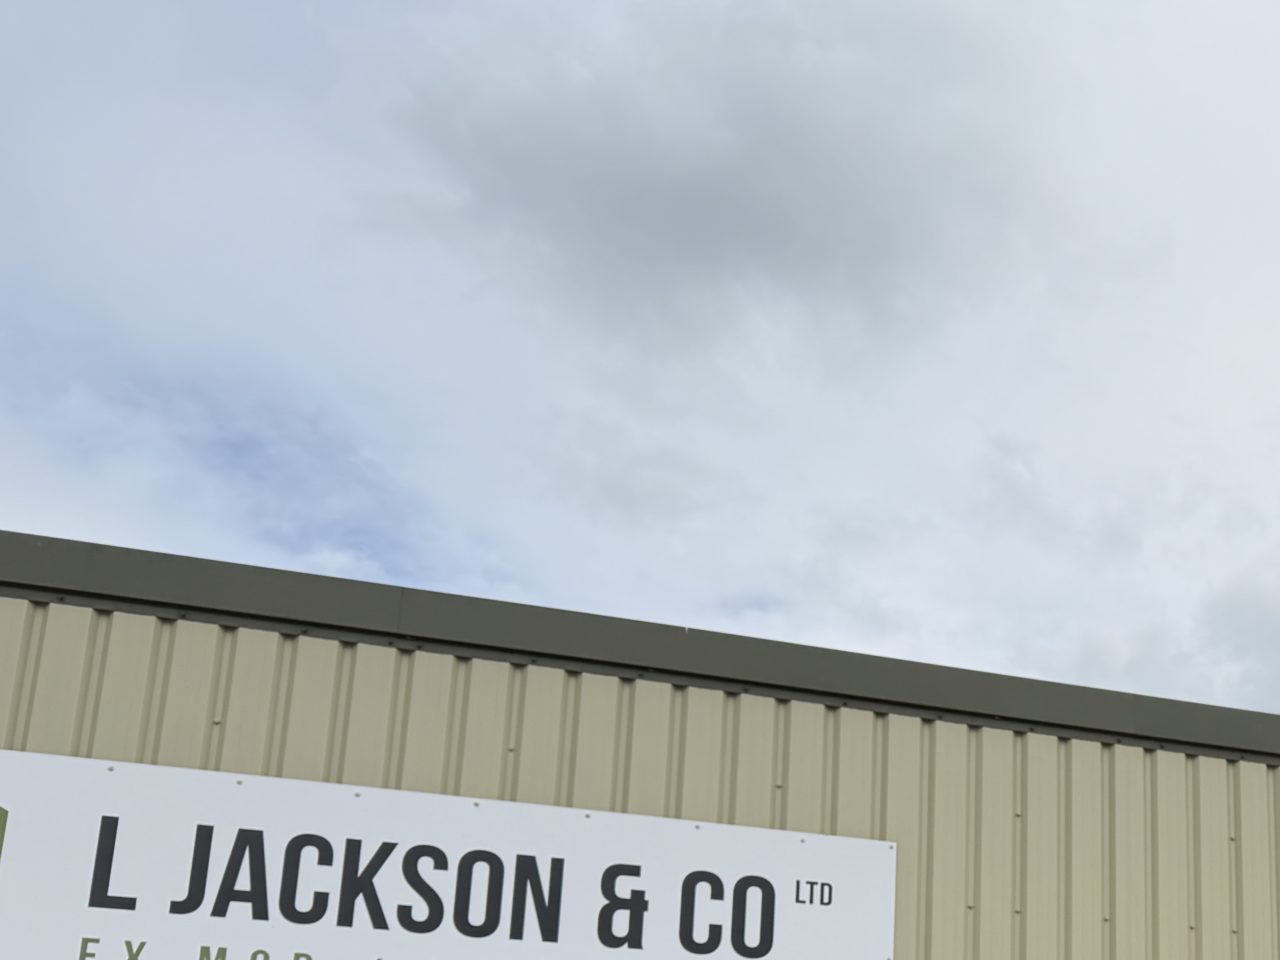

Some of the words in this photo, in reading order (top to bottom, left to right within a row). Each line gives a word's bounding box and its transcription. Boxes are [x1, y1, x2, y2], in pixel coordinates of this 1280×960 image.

[87, 814, 138, 912] L
[168, 823, 566, 944] JACKSON
[596, 863, 650, 951] &
[678, 870, 776, 960] CO
[794, 879, 833, 907] LTD
